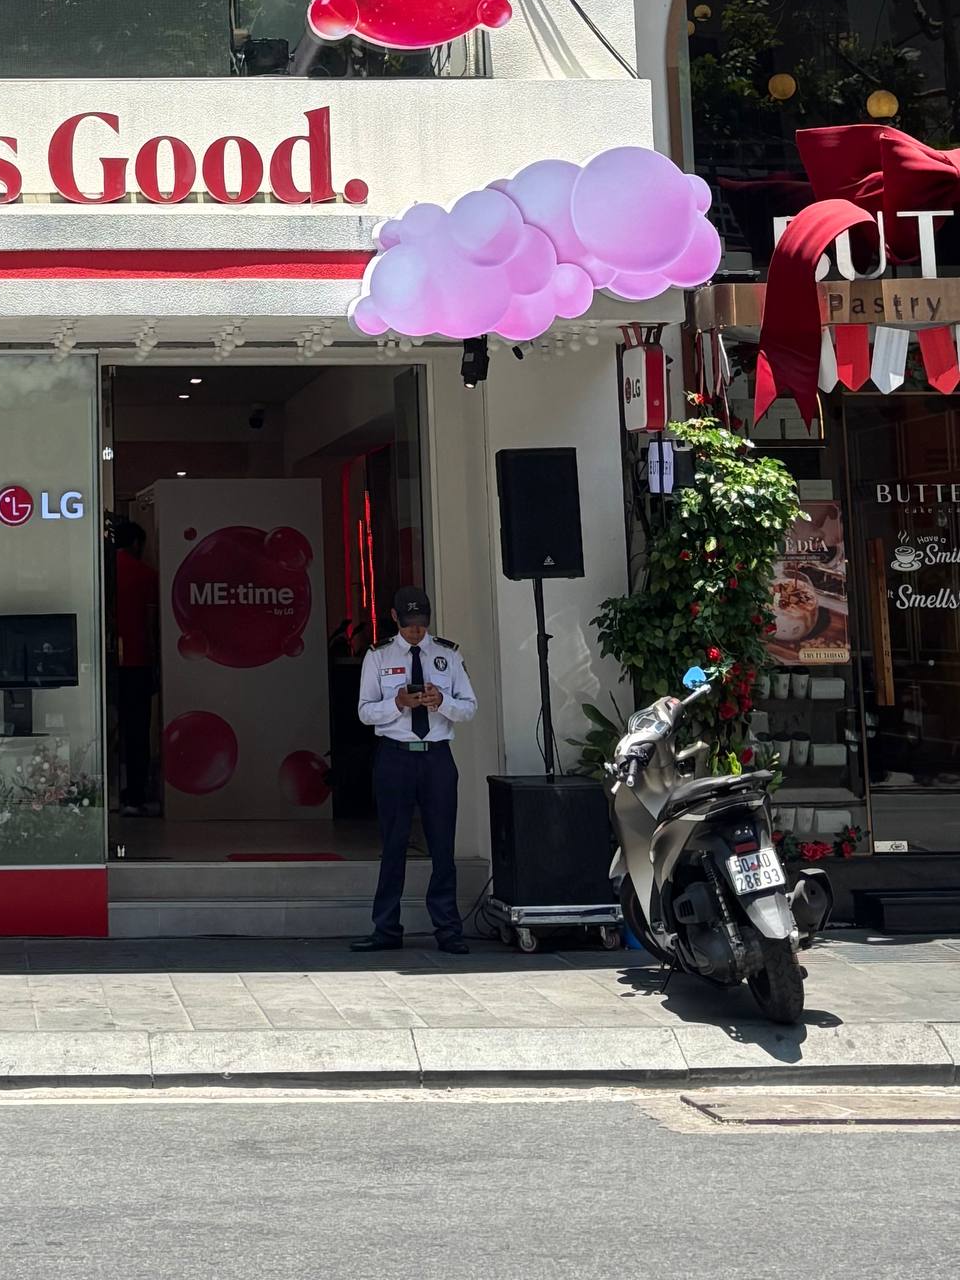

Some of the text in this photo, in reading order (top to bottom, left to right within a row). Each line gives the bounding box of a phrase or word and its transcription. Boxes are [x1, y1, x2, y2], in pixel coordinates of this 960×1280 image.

[48, 105, 369, 205] Good.
[828, 293, 942, 321] Pastry
[41, 491, 84, 519] LG
[189, 582, 295, 605] ME:time
